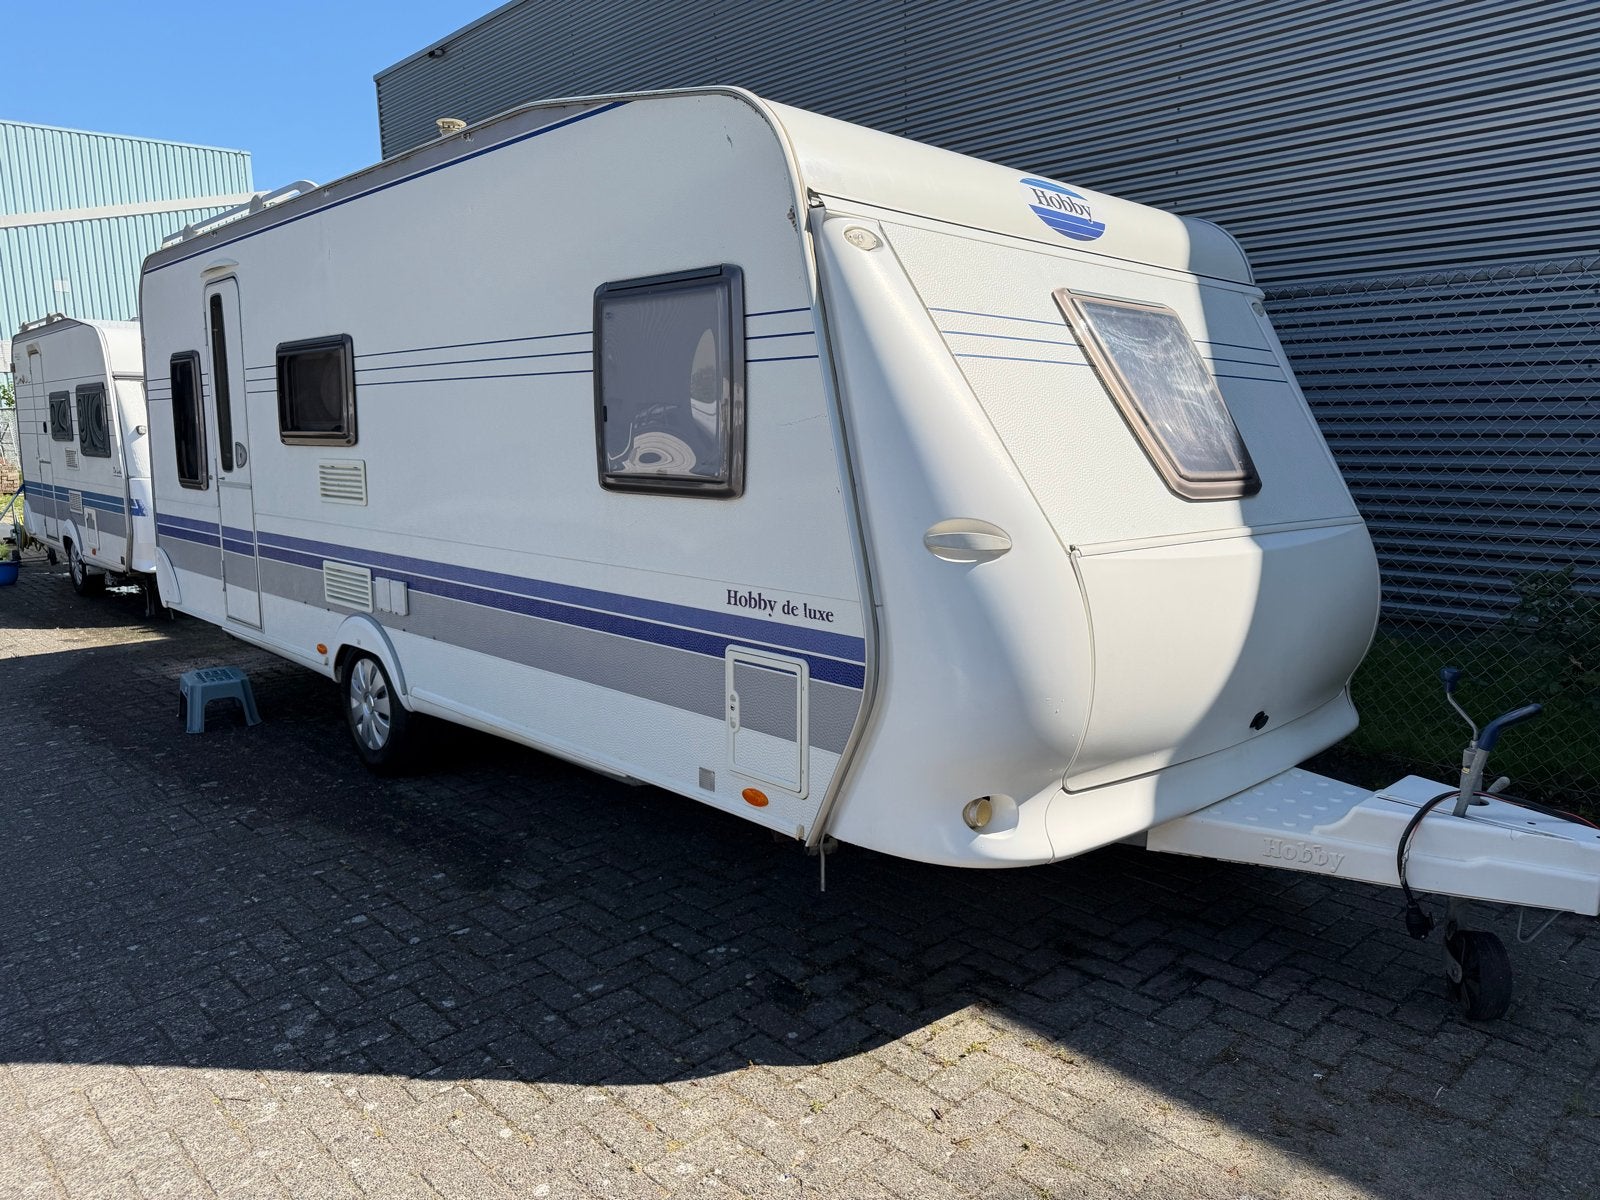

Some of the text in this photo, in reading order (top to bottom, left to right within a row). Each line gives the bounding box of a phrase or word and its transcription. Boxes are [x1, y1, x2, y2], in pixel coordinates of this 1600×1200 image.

[1029, 187, 1093, 223] Hobby
[726, 588, 834, 622] Hobby de luxe
[1262, 837, 1345, 873] Hobby
